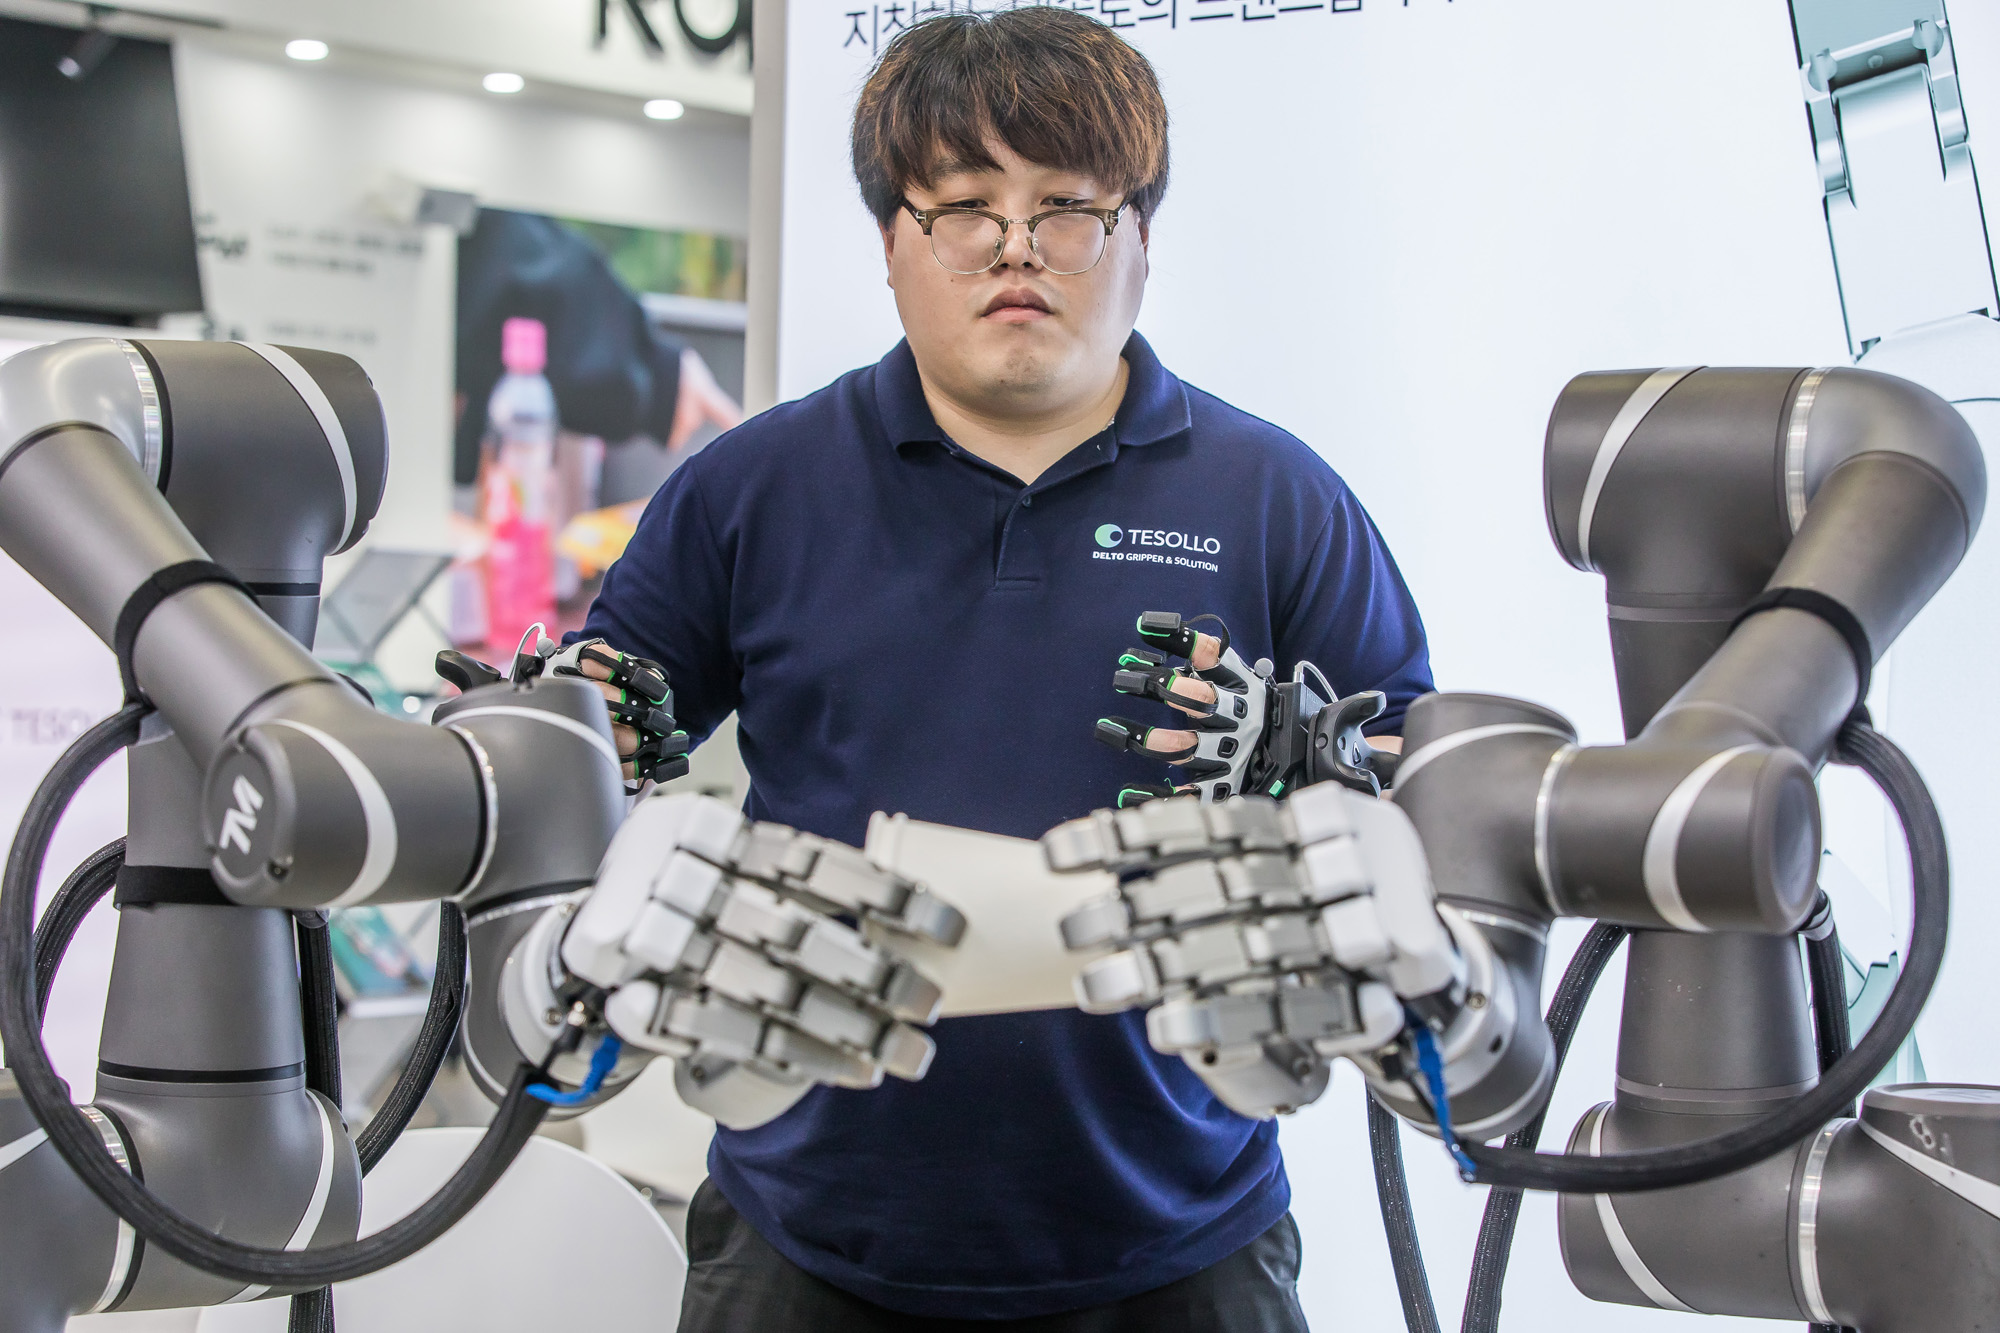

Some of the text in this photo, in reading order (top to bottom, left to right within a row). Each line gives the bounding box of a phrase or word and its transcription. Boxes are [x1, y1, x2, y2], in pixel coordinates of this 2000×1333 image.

[1127, 528, 1221, 555] TESOLLO
[1092, 551, 1219, 573] DELTO GRIPPER & SOLUTION
